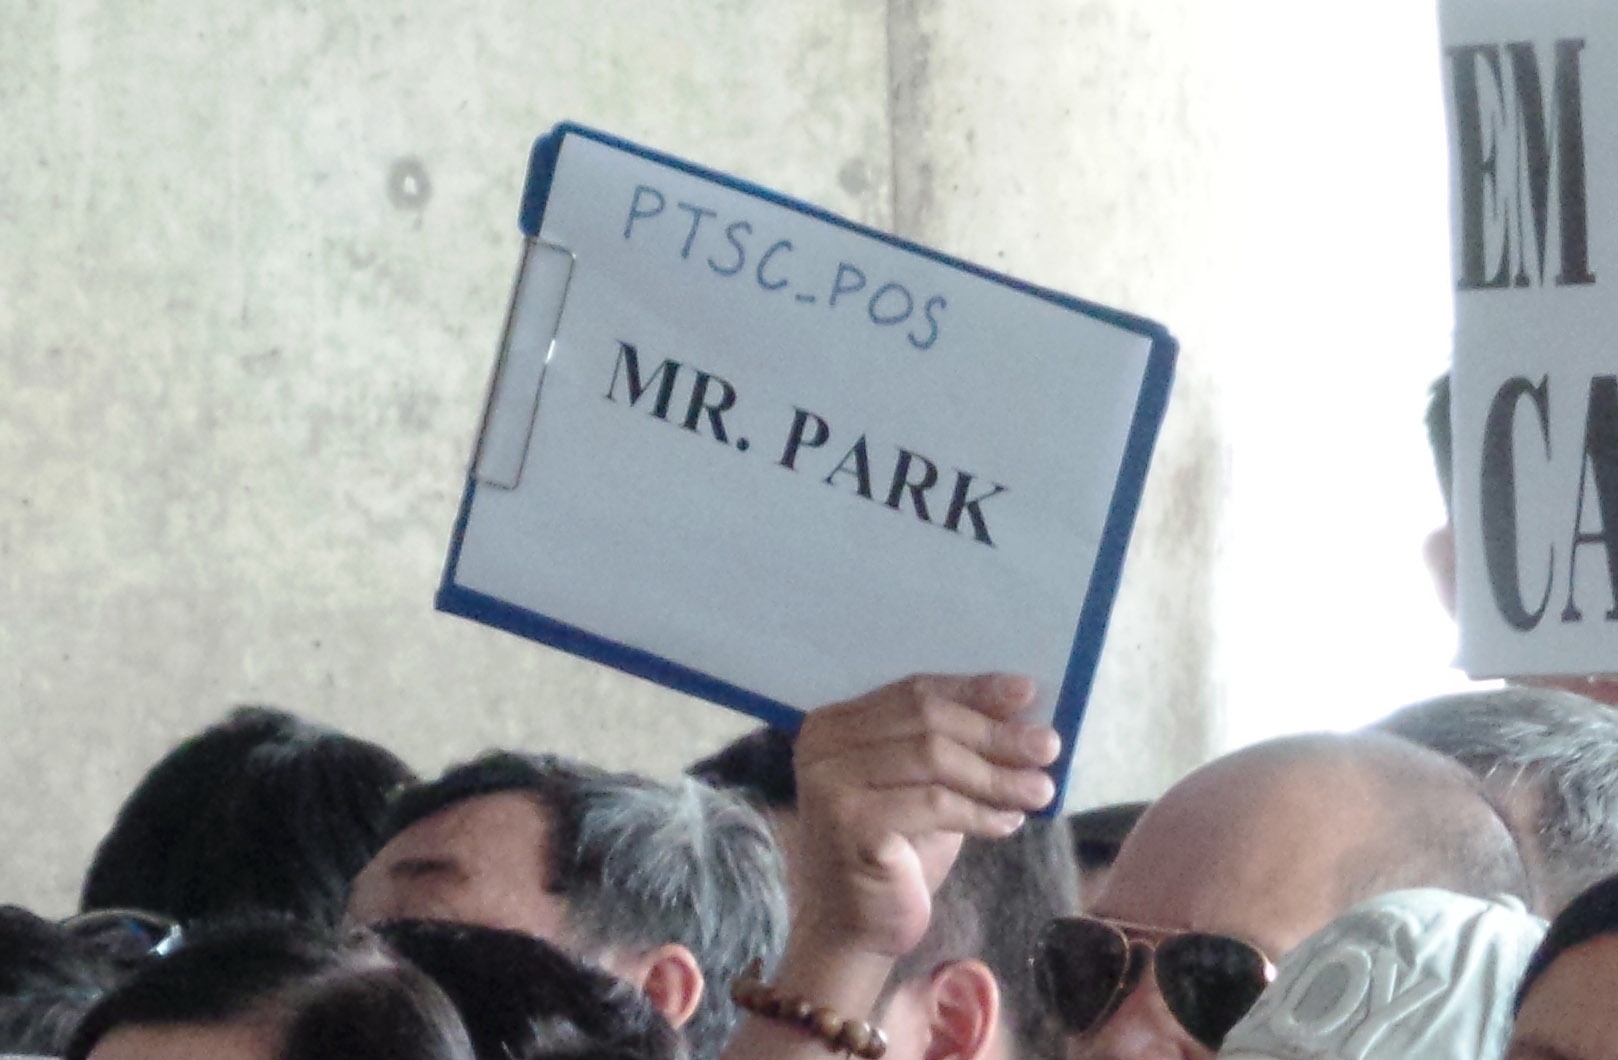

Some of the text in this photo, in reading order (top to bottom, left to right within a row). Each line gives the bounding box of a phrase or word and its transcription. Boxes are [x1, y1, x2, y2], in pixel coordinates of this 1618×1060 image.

[1446, 37, 1596, 291] EM
[605, 340, 1010, 549] MR. PARK
